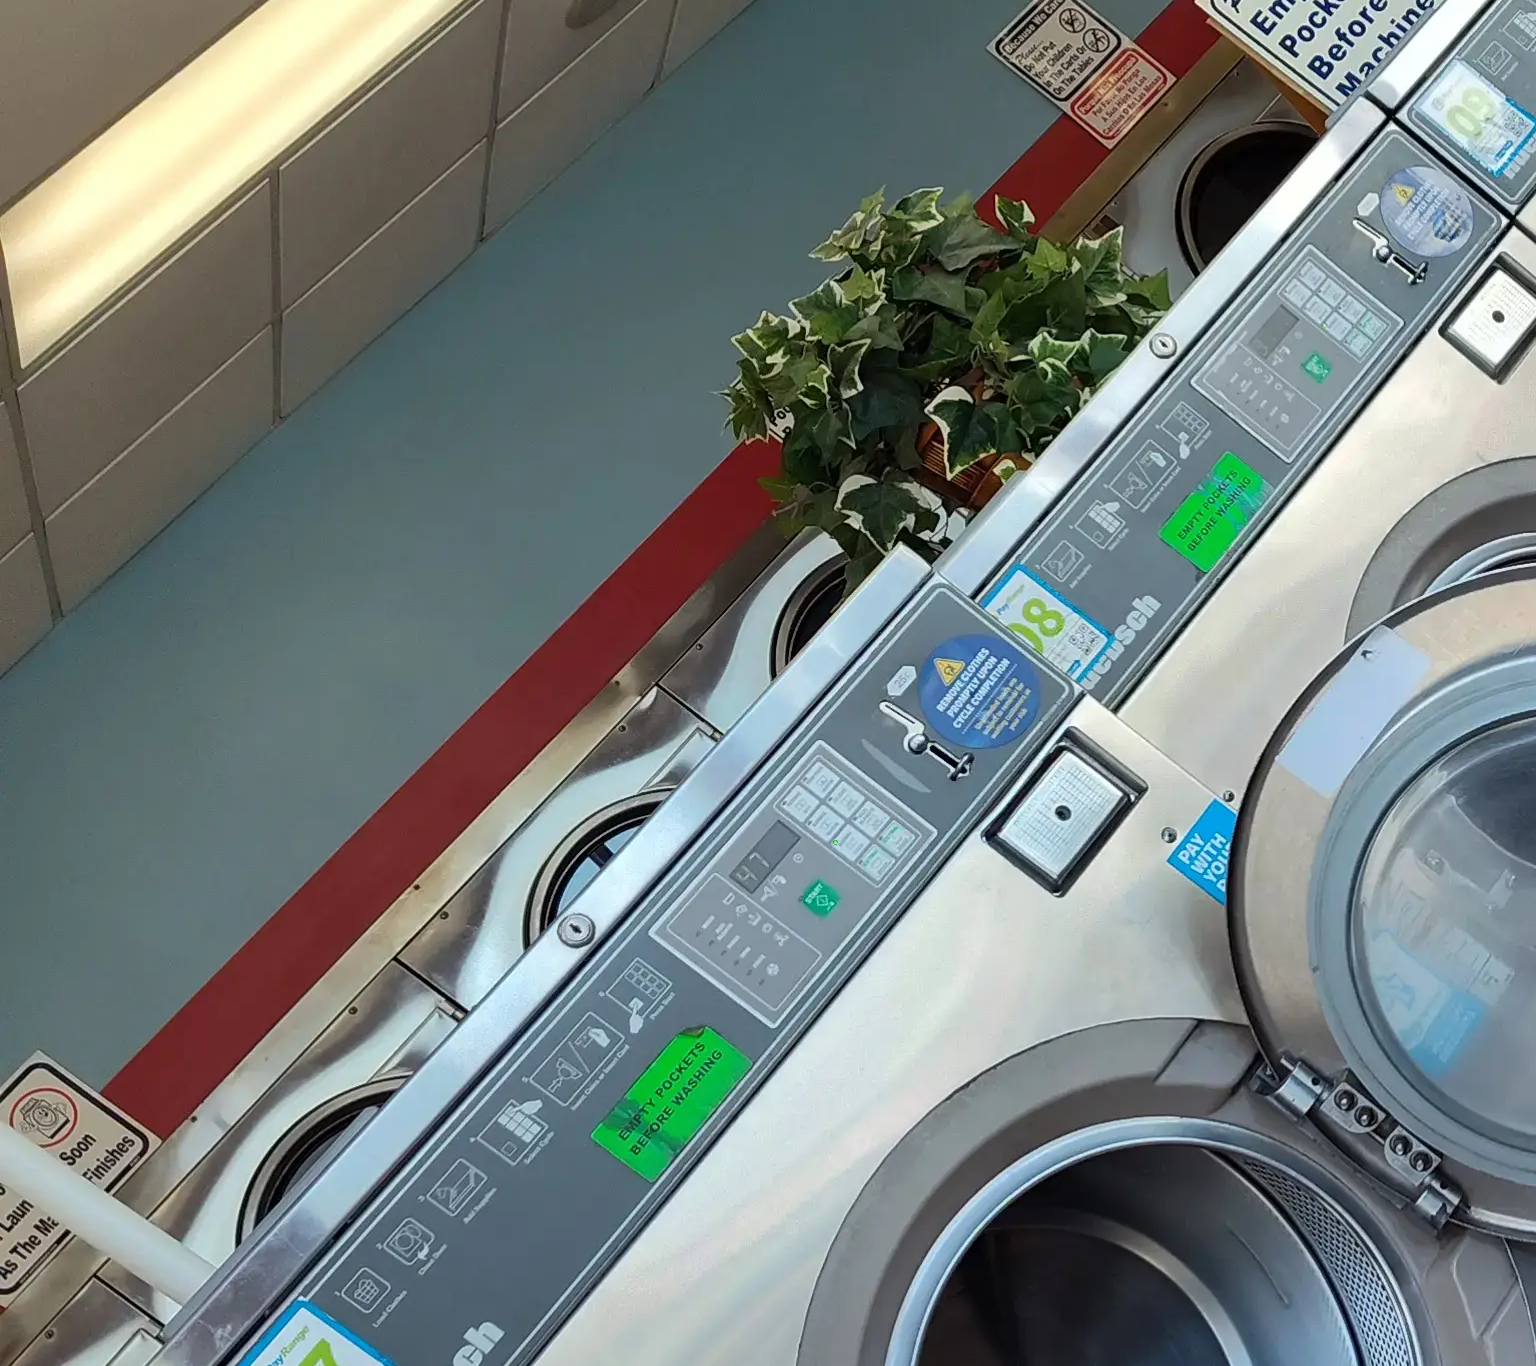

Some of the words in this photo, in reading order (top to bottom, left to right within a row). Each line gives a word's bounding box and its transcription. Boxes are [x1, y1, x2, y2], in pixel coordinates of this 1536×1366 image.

[1002, 21, 1037, 54] Because
[1031, 10, 1048, 26] We
[1023, 60, 1036, 73] Do
[1030, 49, 1047, 65] Not
[1041, 39, 1057, 54] Put
[1032, 63, 1051, 81] Your
[1045, 40, 1073, 68] Children
[1043, 78, 1054, 89] In
[1049, 66, 1065, 82] The
[1060, 51, 1080, 71] Carts
[1075, 43, 1088, 55] Or
[1052, 83, 1066, 96] On
[1061, 72, 1077, 88] The
[1071, 54, 1095, 77] Tables
[1441, 79, 1503, 146] 09
[1176, 509, 1205, 541] EMPTY
[1201, 468, 1238, 510] POCKETS
[1185, 515, 1218, 551] BEFORE
[1214, 476, 1252, 517] WASHING
[935, 678, 966, 713] REMOVE
[960, 646, 991, 682] CLOTHES
[945, 676, 982, 719] PROMPTLY
[976, 654, 999, 681] UPON
[951, 702, 975, 730] CYCLE
[970, 656, 1011, 708] COMPLETION
[1176, 831, 1207, 865] PAY
[1189, 831, 1228, 876] WITH
[804, 882, 825, 906] START
[617, 1097, 657, 1142] EMPTY
[654, 1040, 707, 1099] POCKETS
[629, 1104, 675, 1157] BEFORE
[670, 1047, 724, 1108] WASHING
[57, 1129, 97, 1168] Soon
[81, 1131, 137, 1187] Finishes
[8, 1230, 43, 1263] The
